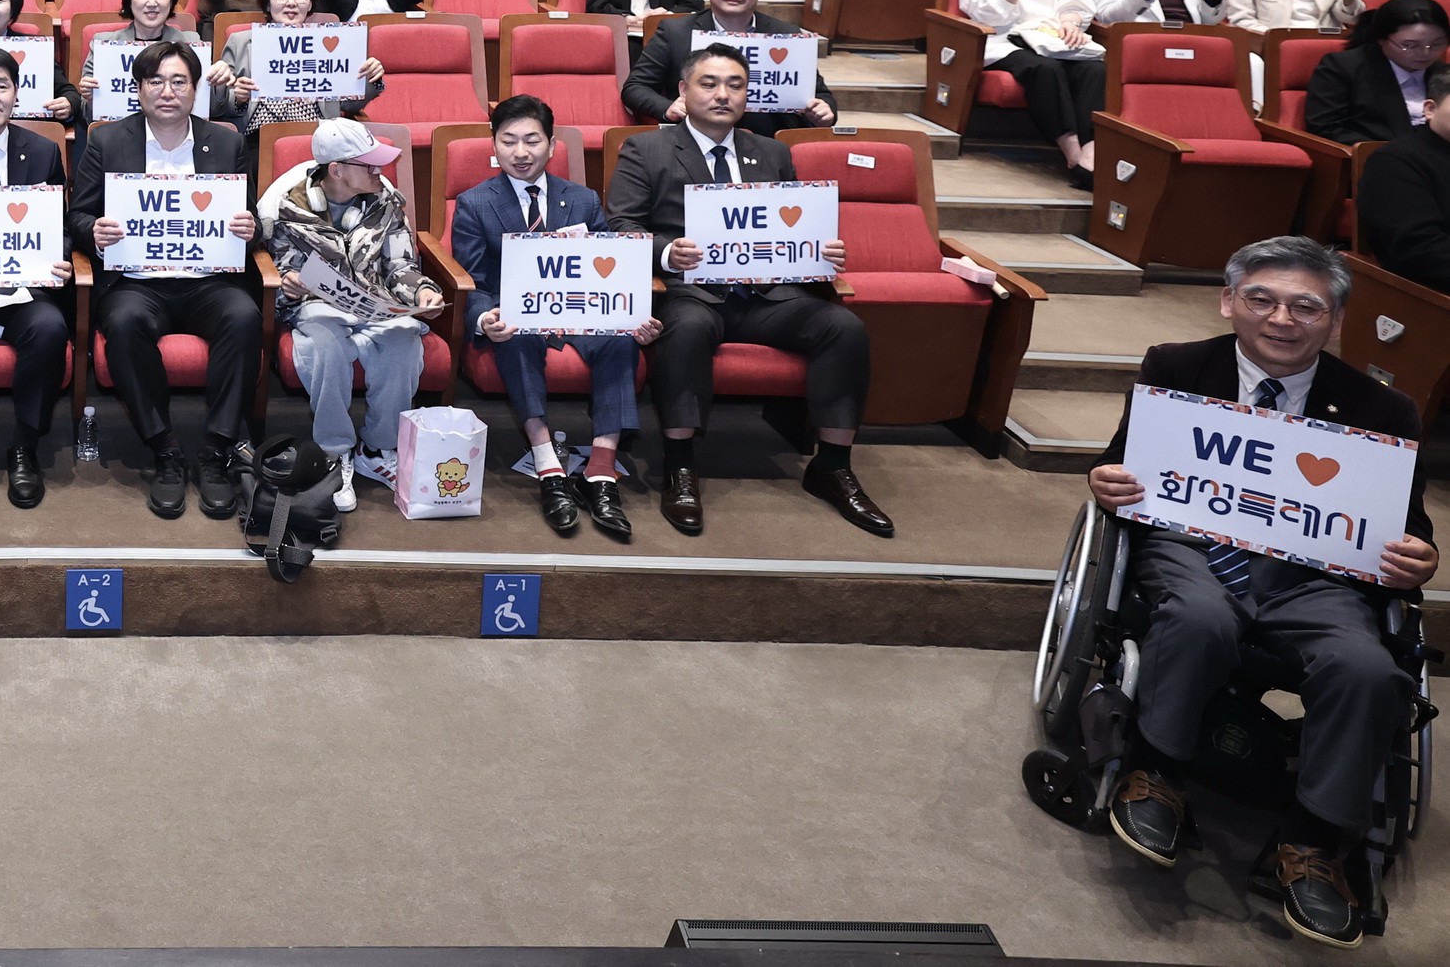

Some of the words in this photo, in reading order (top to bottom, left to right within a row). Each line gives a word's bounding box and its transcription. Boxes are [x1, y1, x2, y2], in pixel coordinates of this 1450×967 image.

[279, 35, 314, 54] WE
[268, 57, 350, 76] 화성특례시
[285, 76, 333, 94] 보건소
[747, 69, 799, 87] 특례시
[745, 88, 779, 105] 건소
[138, 189, 182, 213] WE
[721, 205, 768, 230] WE
[125, 218, 226, 241] 화성특례시
[145, 241, 205, 262] 보건소
[537, 254, 582, 279] WE
[336, 279, 377, 308] WE
[1193, 426, 1276, 476] WE
[78, 574, 111, 586] A-2
[495, 579, 526, 591] A-1
